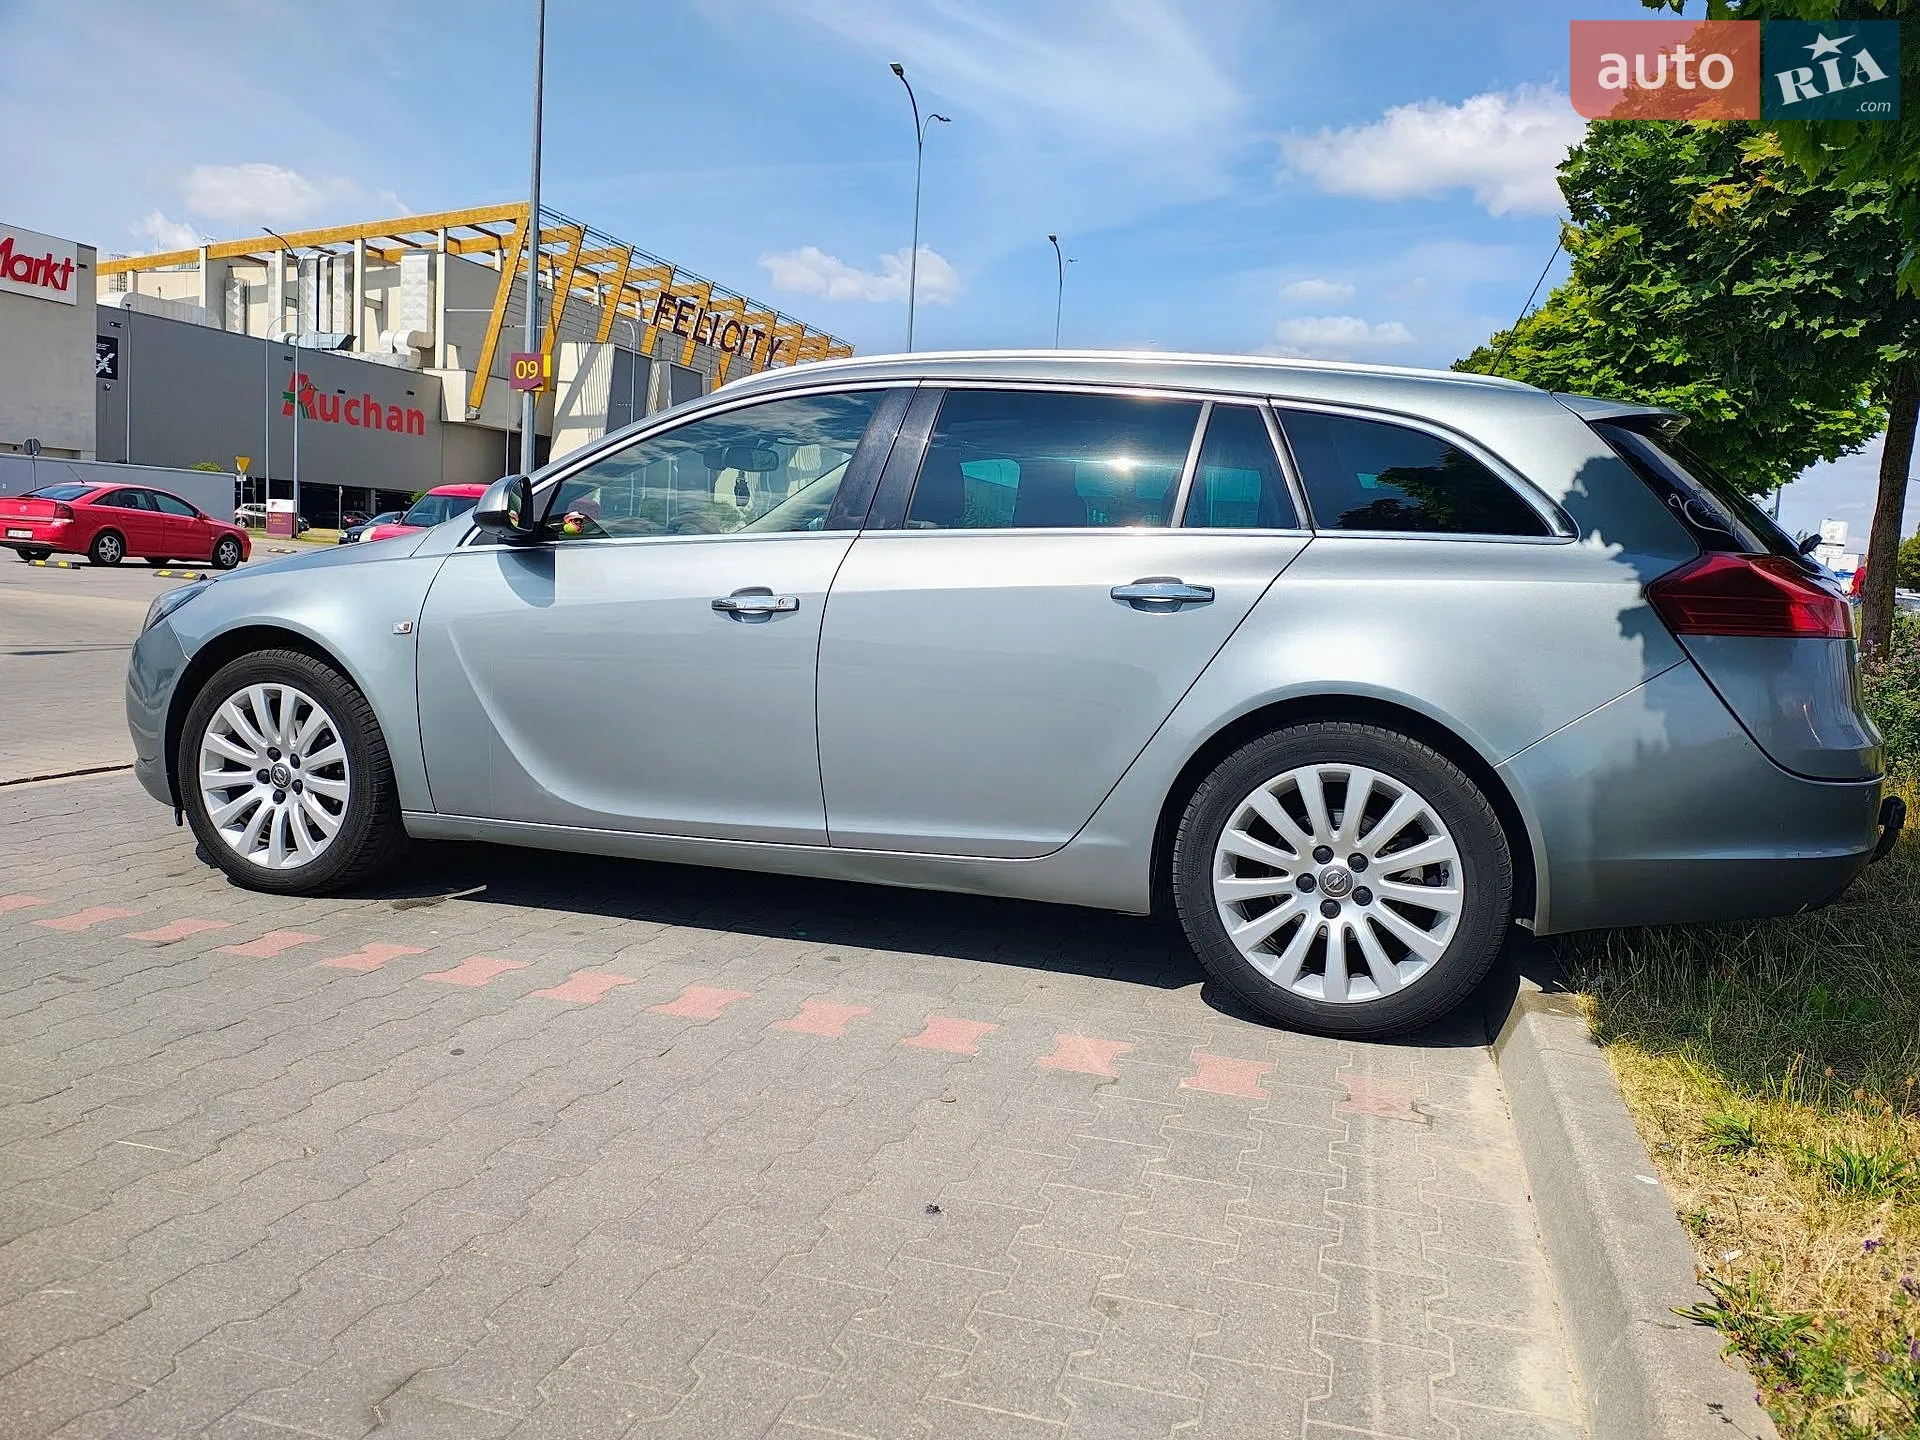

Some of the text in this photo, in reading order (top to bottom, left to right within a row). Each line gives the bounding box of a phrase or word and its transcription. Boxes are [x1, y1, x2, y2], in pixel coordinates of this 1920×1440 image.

[651, 291, 784, 368] FELICITY
[515, 360, 539, 380] 09
[282, 372, 425, 436] Auchan
